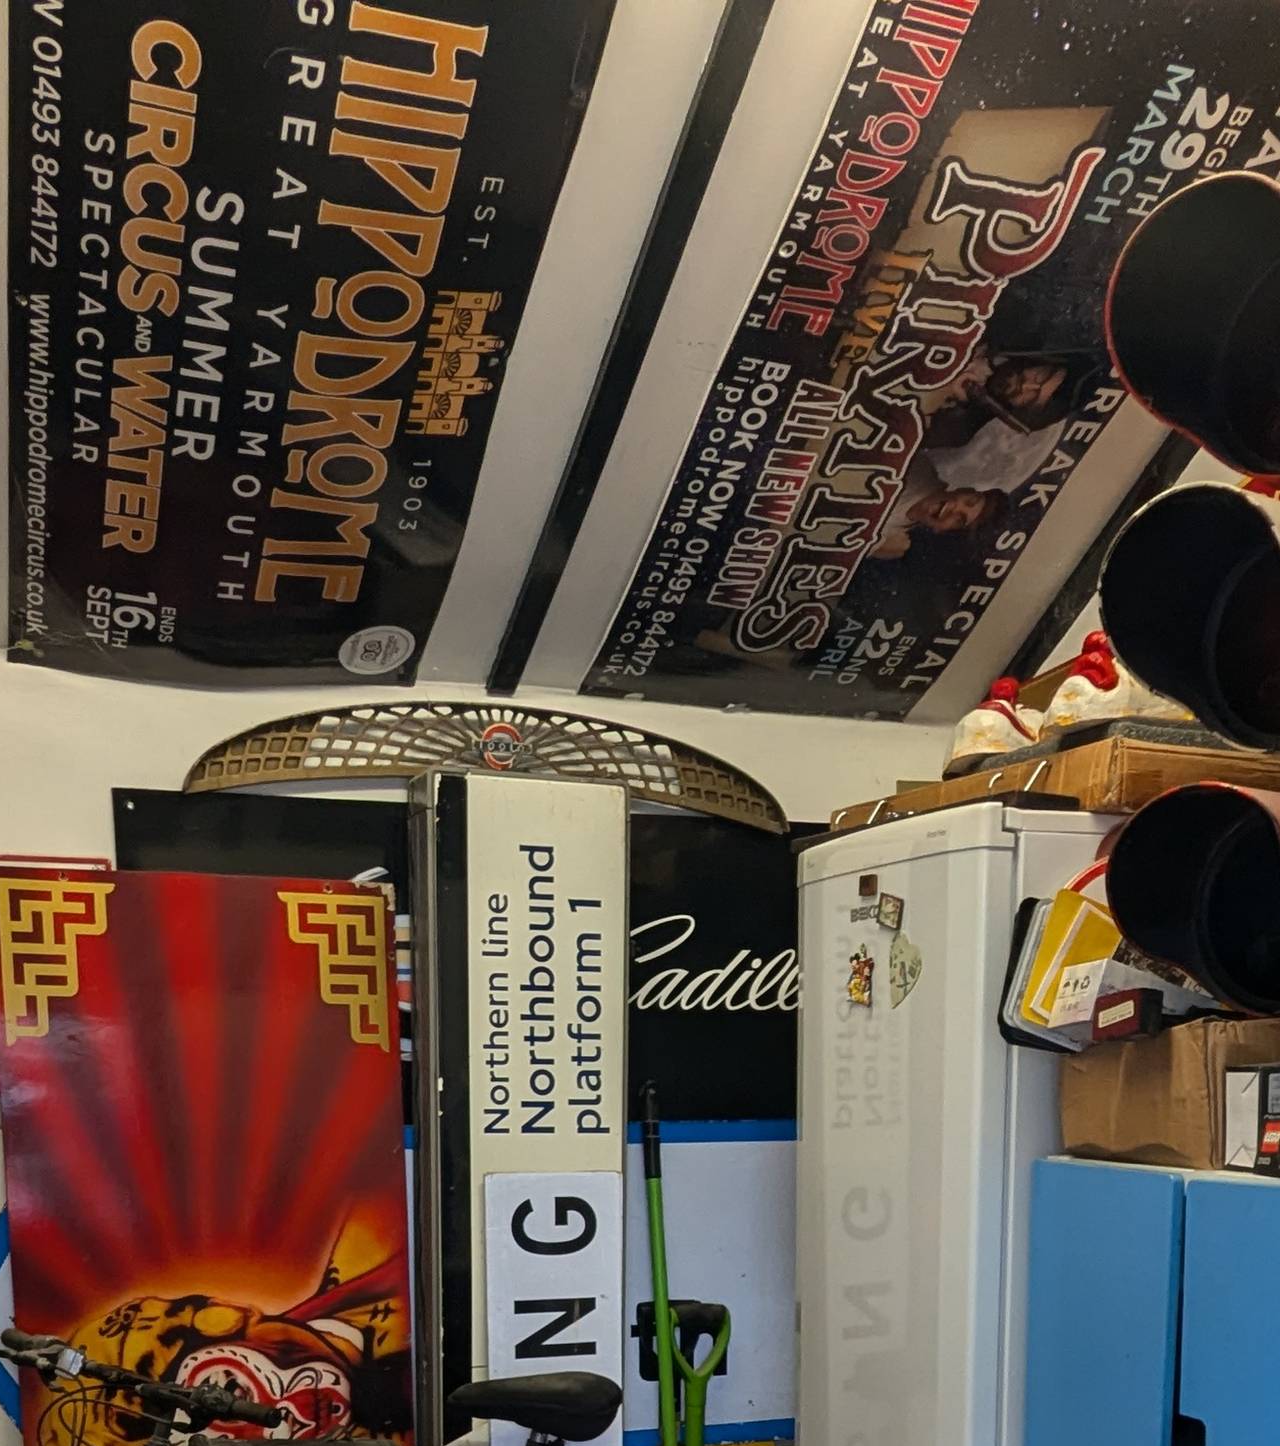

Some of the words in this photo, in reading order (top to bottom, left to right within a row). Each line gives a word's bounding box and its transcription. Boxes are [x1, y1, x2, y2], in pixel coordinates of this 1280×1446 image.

[31, 36, 63, 147] 01493
[847, 0, 900, 99] EAT
[117, 19, 203, 318] CIRCUS
[268, 0, 335, 249] GREAT
[1084, 64, 1196, 224] MARCH
[30, 153, 60, 268] 844172
[462, 176, 505, 263] EST.
[746, 128, 850, 329] YARMOUTH
[72, 128, 116, 464] SPECTACULAR
[135, 314, 152, 352] AND
[171, 186, 246, 462] SUMMER
[254, 1, 489, 603] HIPPODROME
[101, 354, 174, 554] WATER
[217, 303, 290, 601] YARMOUTH
[729, 361, 792, 453] BOOK
[735, 147, 1107, 653] PIRATES
[775, 379, 846, 443] ALL
[1020, 364, 1126, 508] REAK
[24, 295, 54, 635] www.hippodromecircus.co.uk
[398, 458, 432, 533] 1903
[602, 356, 764, 676] hippodromecircus.co.uk
[696, 459, 747, 532] NOW
[745, 448, 818, 524] NEW
[86, 584, 113, 645] SEPT
[661, 537, 710, 605] 01493
[708, 527, 783, 610] SHOW
[900, 529, 1027, 690] SPECIAL
[158, 606, 177, 643] ENDS
[622, 610, 676, 677] 844172
[809, 616, 865, 682] APRIL
[878, 635, 917, 677] ENDS
[483, 891, 512, 960] line
[570, 896, 601, 910] 1
[519, 844, 557, 1136] Northbound
[630, 914, 802, 1012] Cadill
[483, 969, 512, 1136] Northern
[568, 937, 611, 1136] platform
